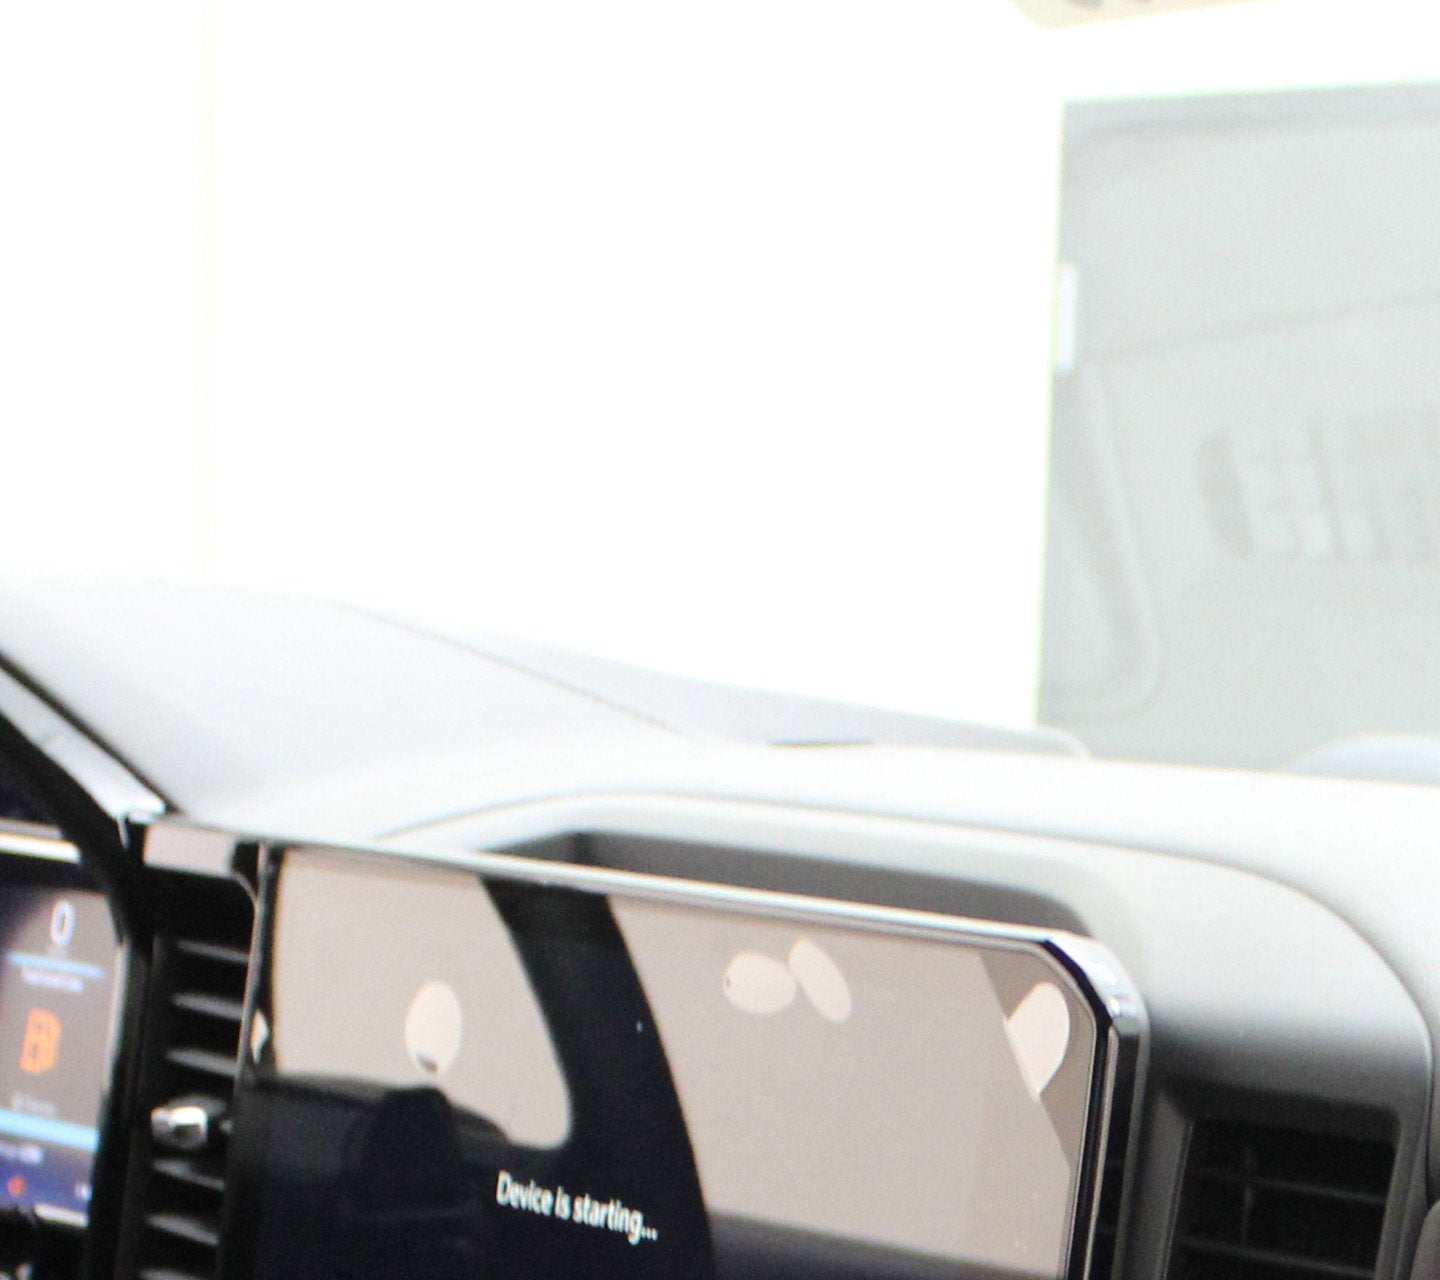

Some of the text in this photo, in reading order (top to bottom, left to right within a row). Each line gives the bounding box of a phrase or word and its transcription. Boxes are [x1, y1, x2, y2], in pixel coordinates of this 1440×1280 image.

[496, 1170, 659, 1246] Device is starting...
